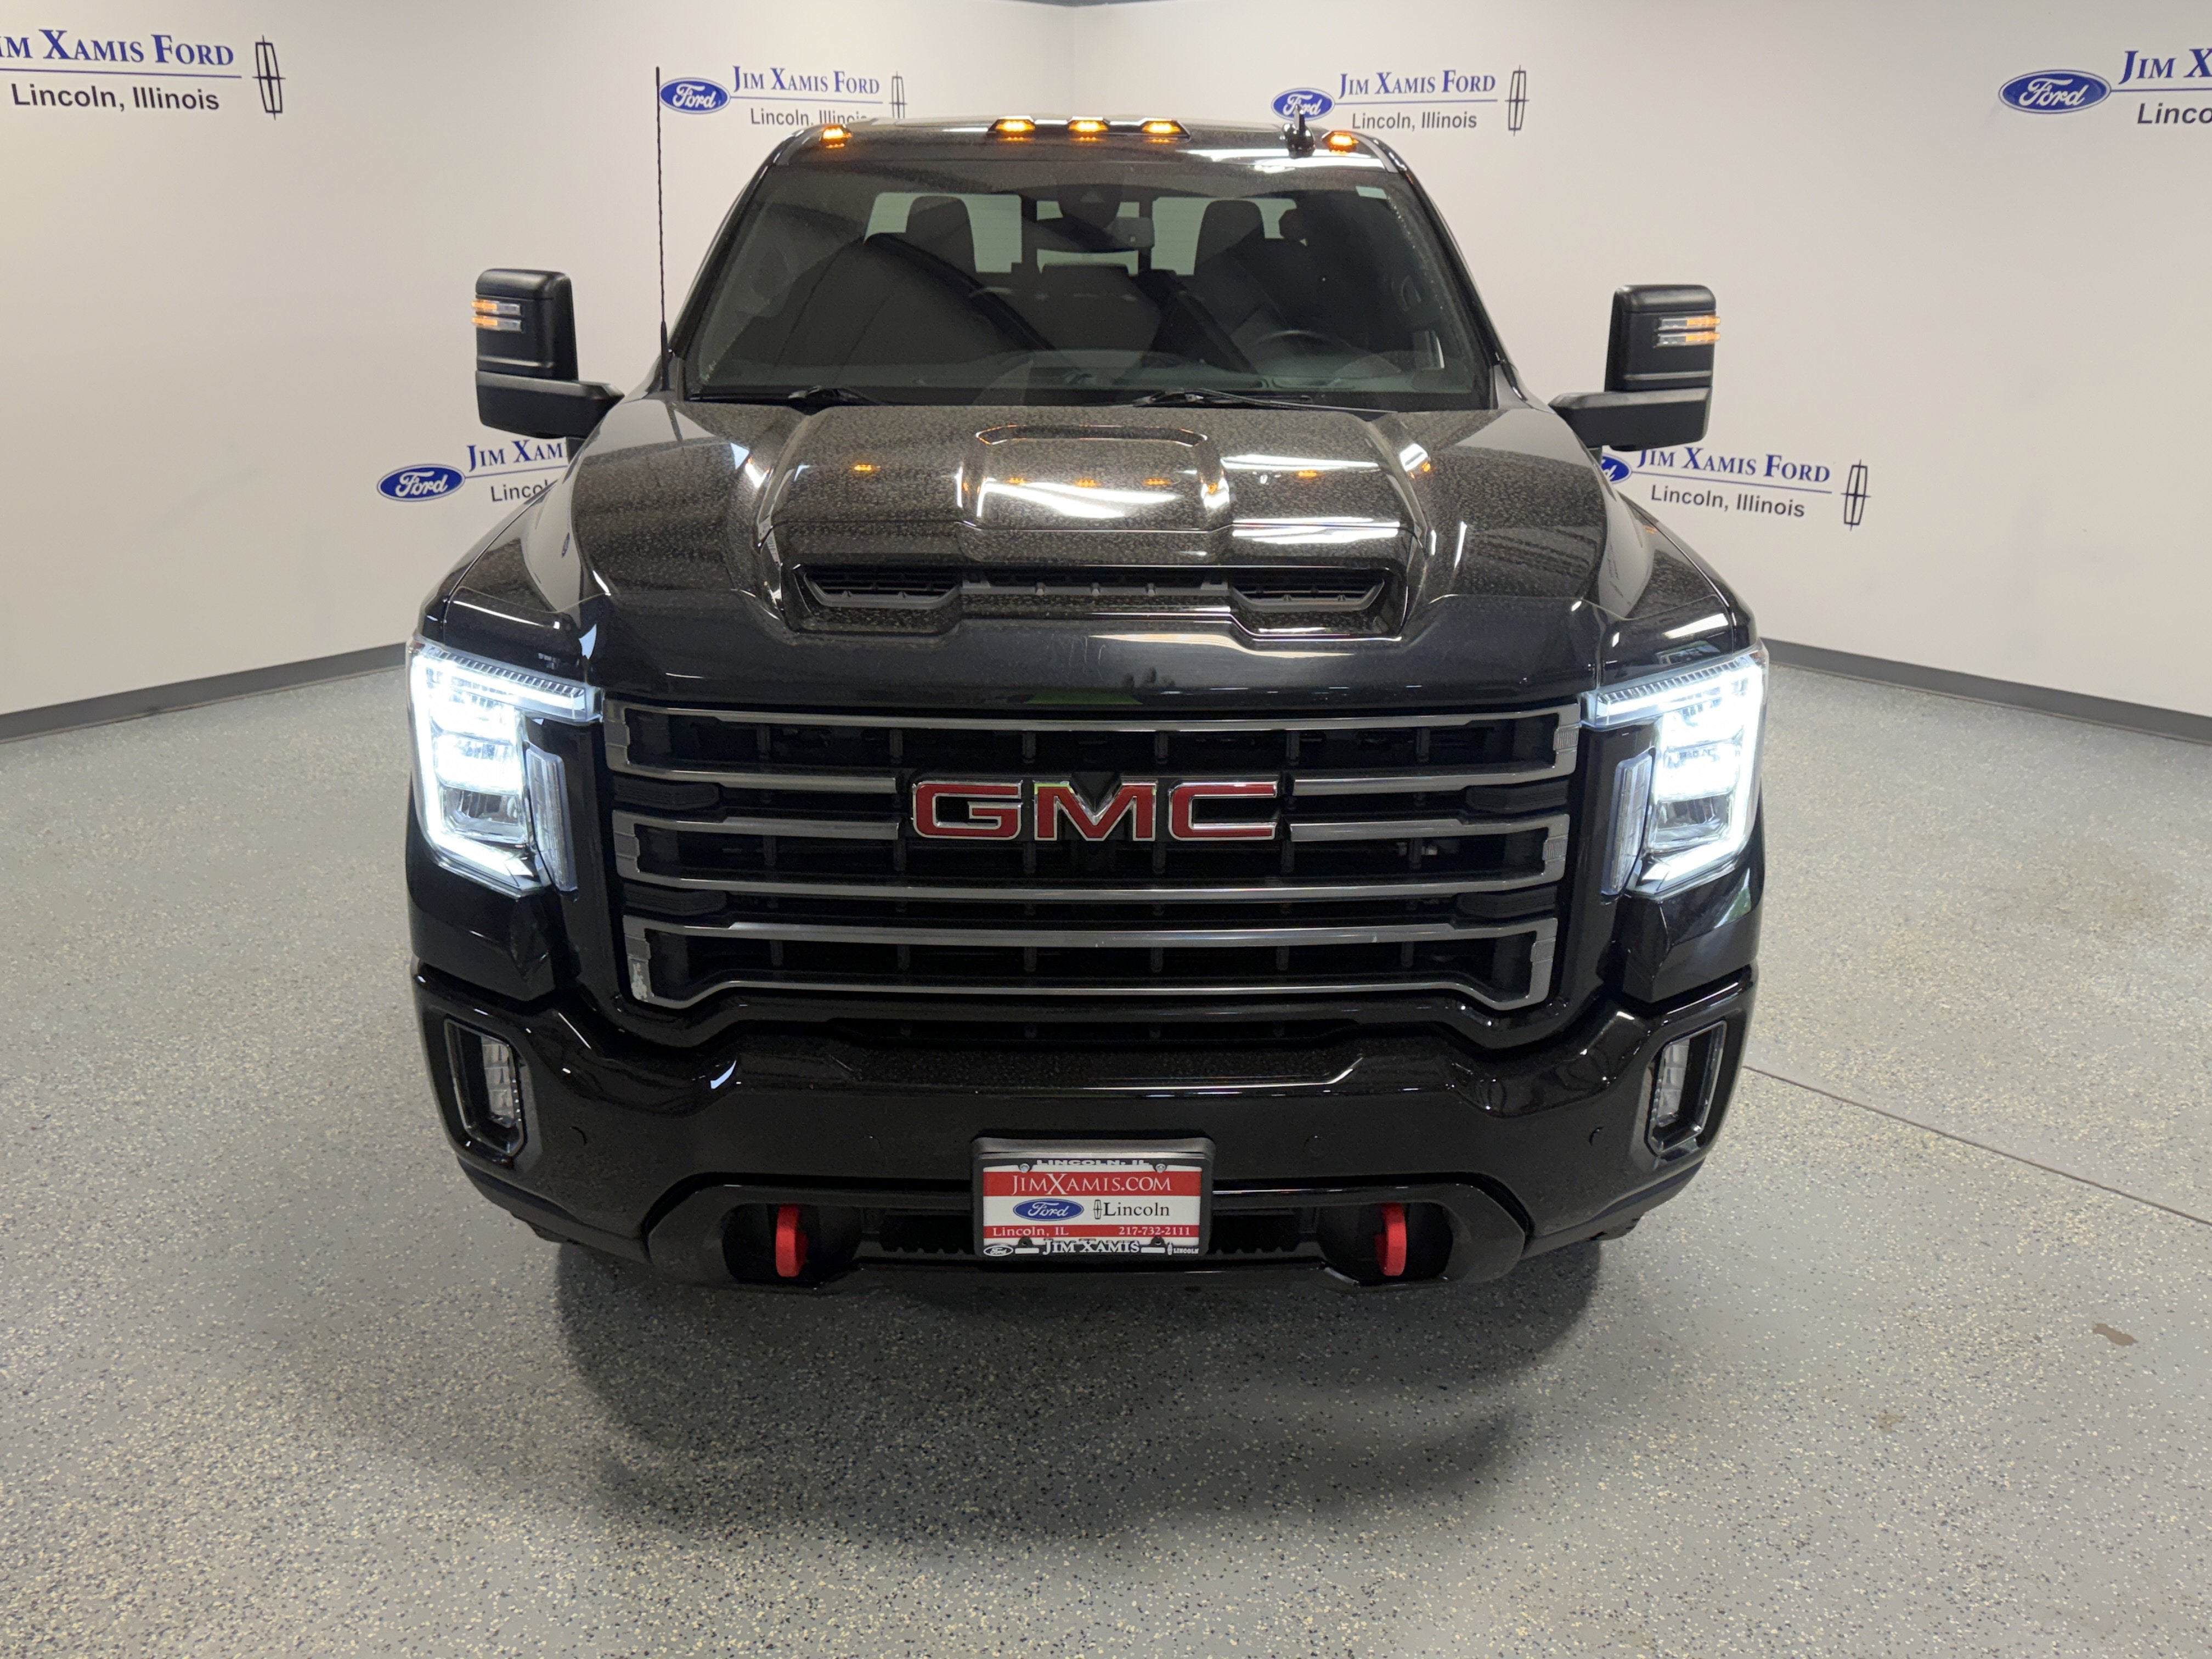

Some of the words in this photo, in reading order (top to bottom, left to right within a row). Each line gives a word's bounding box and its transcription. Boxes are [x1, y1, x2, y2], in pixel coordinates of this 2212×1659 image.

[38, 29, 144, 63] XAMIS
[151, 34, 234, 65] FORD
[732, 65, 765, 93] JIM
[770, 67, 828, 93] XAMIS
[833, 70, 879, 94] FORD
[2118, 50, 2176, 84] JIM
[1339, 73, 1369, 99] JIM
[1376, 71, 1436, 95] XAMIS
[1442, 69, 1496, 93] FORD
[11, 83, 125, 112] Lincoln,
[133, 86, 219, 110] Illinois
[819, 109, 867, 124] Illinoi
[1352, 112, 1415, 132] Lincoln,
[1421, 111, 1477, 128] Illinois
[2137, 103, 2212, 124] Linco
[466, 444, 505, 473] JIM
[511, 439, 567, 464] XAM
[1637, 450, 1677, 468] JIM
[1684, 447, 1757, 476] XAMIS
[1764, 454, 1831, 483] FORD
[491, 479, 548, 502] Linco
[1651, 484, 1729, 511] Lincoln,
[1737, 493, 1805, 517] Illinois
[911, 780, 1278, 841] GMC
[1011, 1172, 1172, 1195] JIMXAMIS.COM
[1103, 1201, 1170, 1217] Lincoln
[993, 1226, 1049, 1237] Lincoln,
[1055, 1226, 1069, 1235] IL
[1119, 1226, 1190, 1235] 217-732-2111
[1043, 1239, 1076, 1255] JIM
[1079, 1239, 1139, 1253] XAMIS
